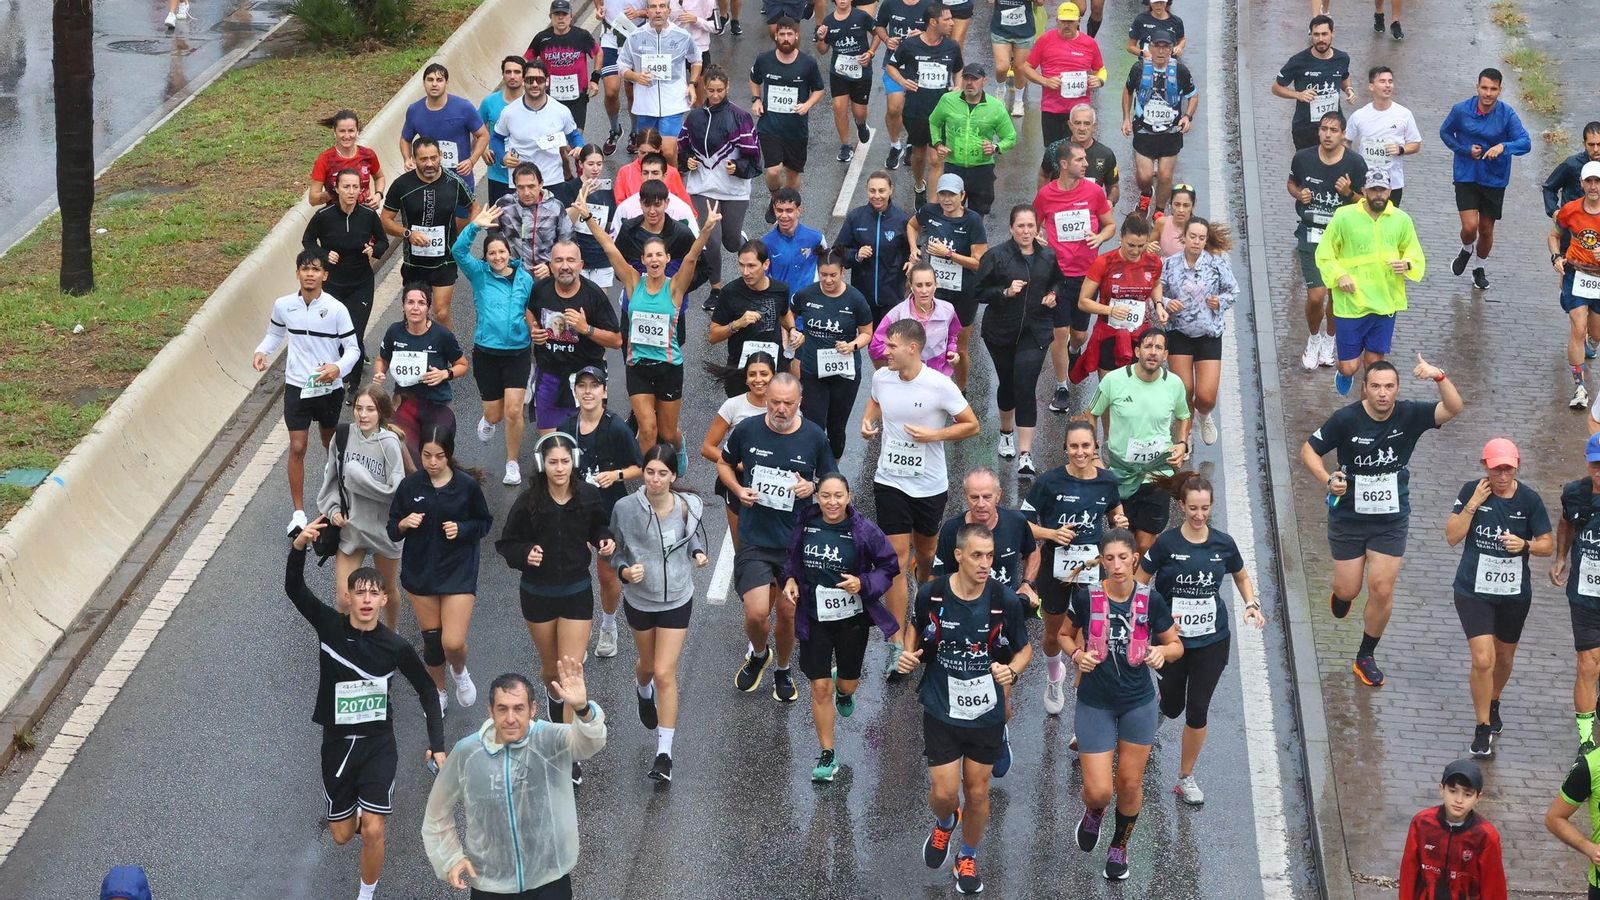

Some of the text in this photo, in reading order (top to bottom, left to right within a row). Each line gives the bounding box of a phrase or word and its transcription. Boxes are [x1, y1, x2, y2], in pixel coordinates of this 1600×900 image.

[840, 63, 858, 71] 3766
[921, 73, 945, 81] 11311
[555, 85, 575, 93] 1315
[1067, 81, 1084, 90] 1446
[772, 96, 793, 105] 7409
[1316, 103, 1335, 113] 1377
[1146, 109, 1170, 119] 11320
[1062, 222, 1085, 232] 6927
[638, 325, 663, 336] 6932
[567, 343, 575, 352] ti
[395, 365, 420, 376] 6813
[825, 361, 849, 372] 6931
[888, 452, 922, 467] 12882
[756, 482, 791, 498] 12761
[1362, 490, 1392, 502] 6623
[1485, 571, 1515, 583] 6703
[825, 596, 855, 609] 6814
[1178, 612, 1214, 625] 10265
[340, 697, 383, 713] 20707
[957, 693, 989, 707] 6864
